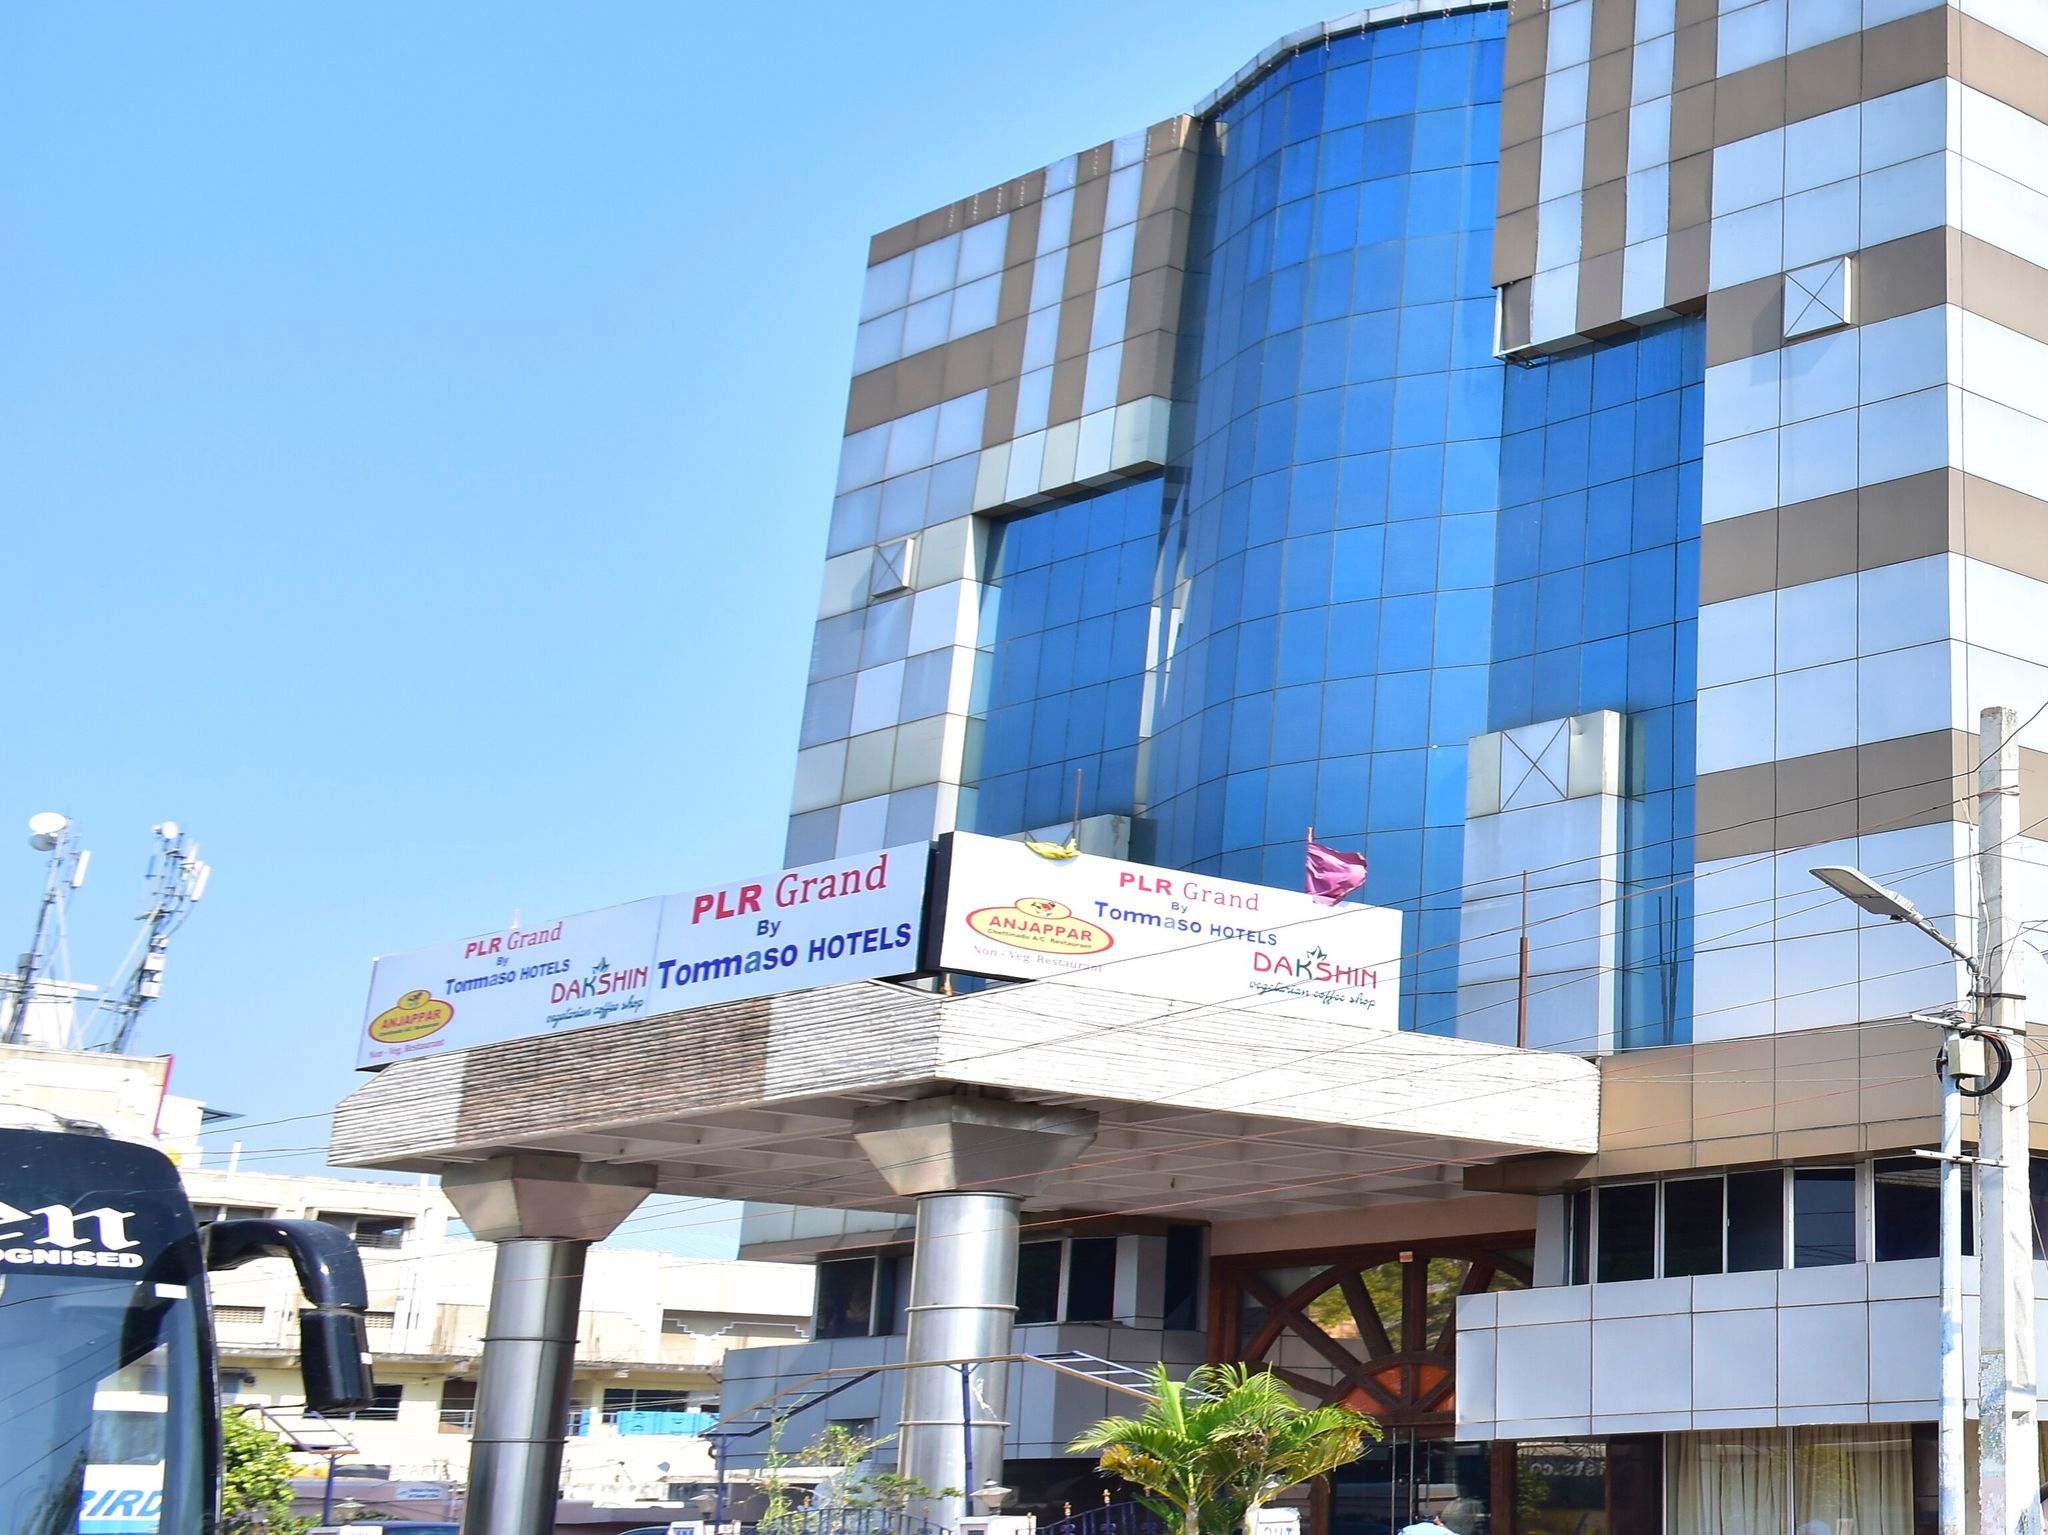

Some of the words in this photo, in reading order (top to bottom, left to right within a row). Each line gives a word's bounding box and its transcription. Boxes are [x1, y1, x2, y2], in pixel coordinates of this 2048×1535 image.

[691, 884, 763, 924] PLR
[775, 854, 888, 908] Grand
[1119, 872, 1172, 895] PLR
[1183, 882, 1259, 911] Grand
[1171, 901, 1188, 913] By
[464, 937, 502, 959] PLR
[507, 921, 563, 950] Grand
[756, 919, 782, 937] By
[988, 916, 1092, 941] ANJAPPAR
[1094, 901, 1202, 933] Tommaso
[1209, 923, 1278, 946] HOTELS
[657, 944, 798, 989] Tommaso
[807, 922, 912, 963] HOTELS
[973, 945, 997, 957] Non
[446, 970, 517, 995] Tommaso
[520, 959, 570, 981] HOTELS
[551, 966, 648, 1003] DAKSHIN
[1253, 951, 1377, 989] DAKSHIN
[0, 1247, 144, 1268] GNISED
